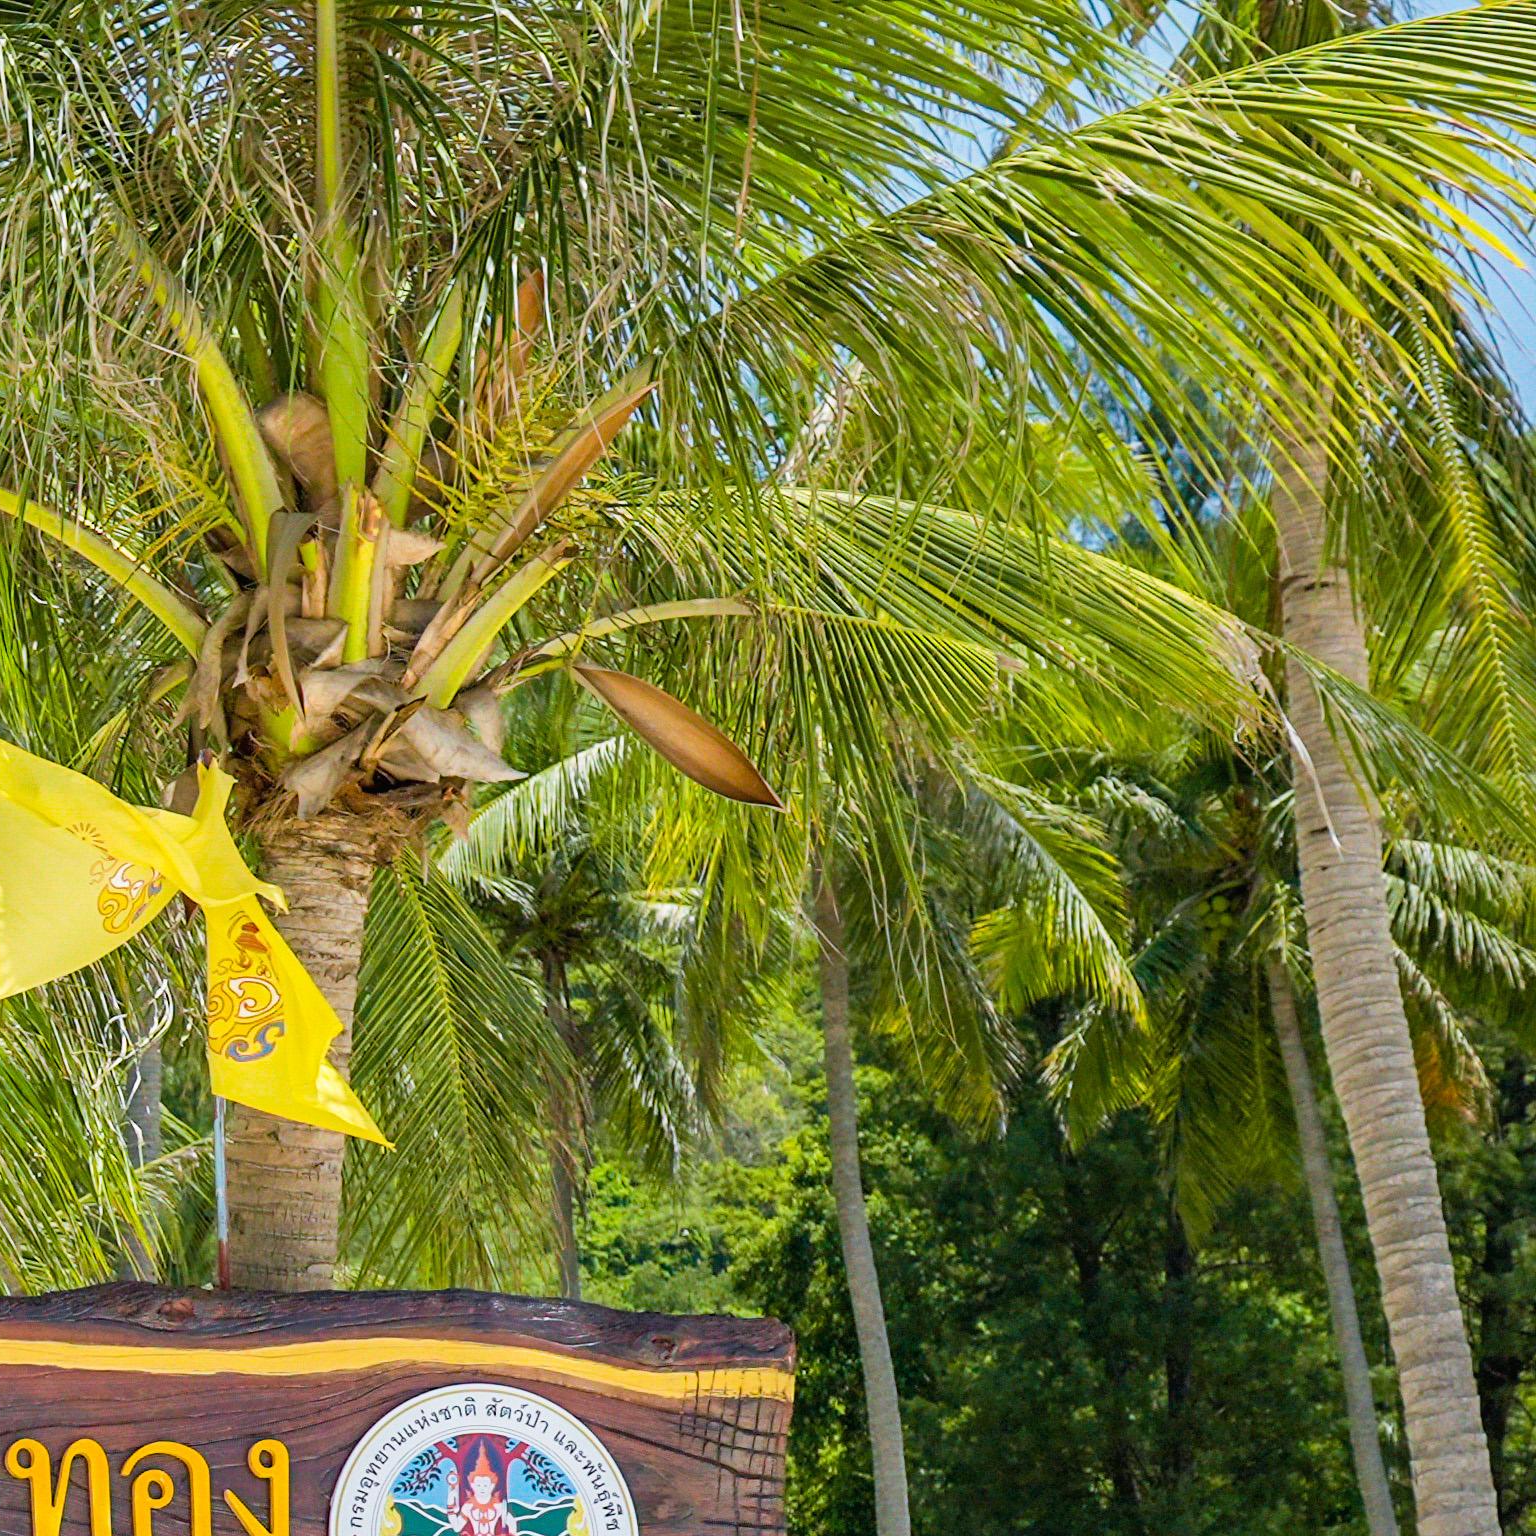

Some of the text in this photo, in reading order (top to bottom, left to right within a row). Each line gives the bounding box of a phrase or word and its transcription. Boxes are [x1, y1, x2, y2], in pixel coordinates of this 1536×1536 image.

[350, 1397, 477, 1528] กรมอุทยานแห่งชาติ
